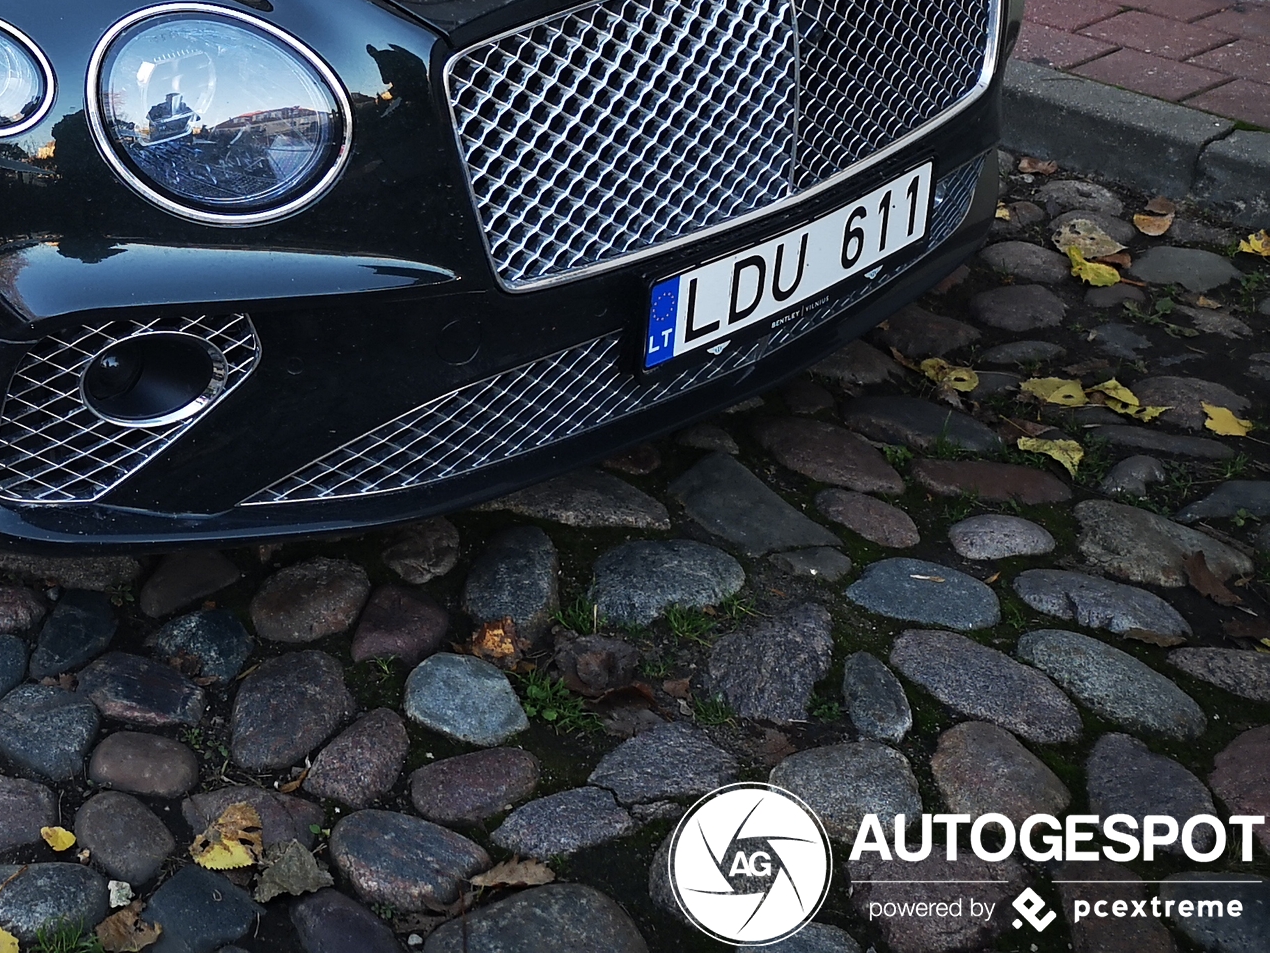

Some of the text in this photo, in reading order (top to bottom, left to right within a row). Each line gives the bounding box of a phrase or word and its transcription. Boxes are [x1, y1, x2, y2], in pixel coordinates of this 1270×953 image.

[684, 174, 920, 343] LDU 611
[771, 295, 830, 328] BENTLEY VILNIUS
[648, 327, 673, 354] LT
